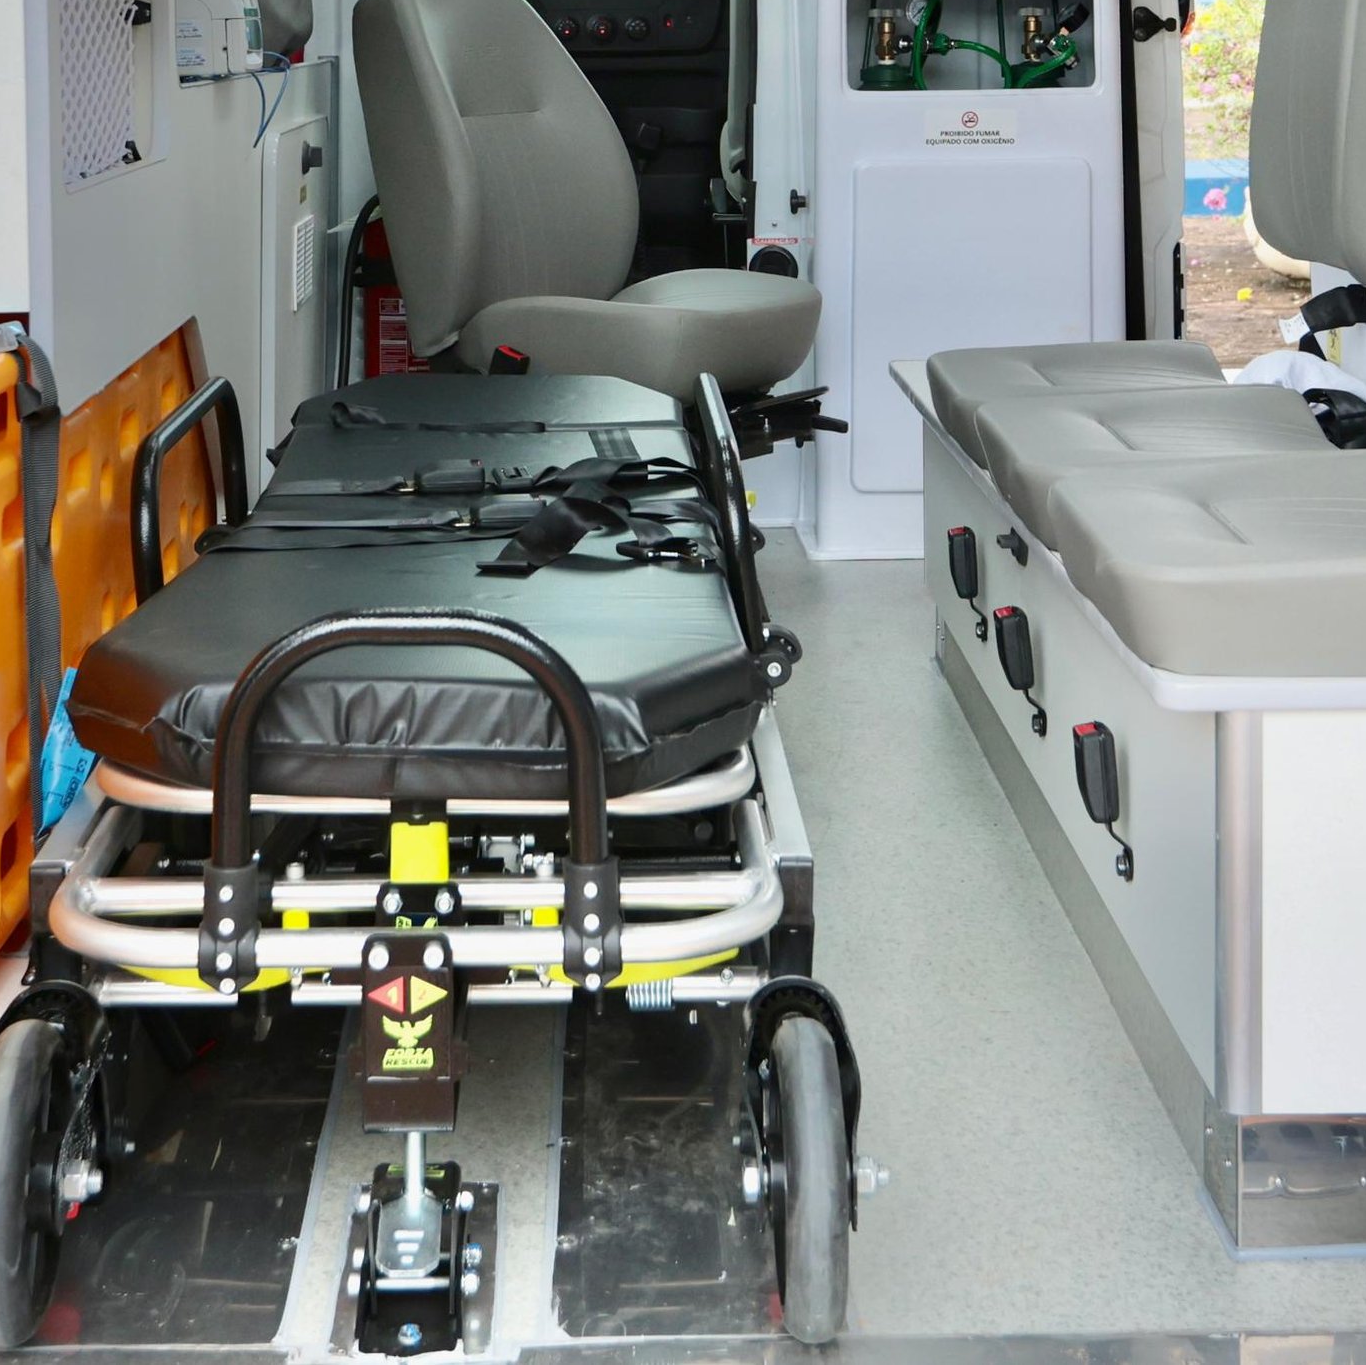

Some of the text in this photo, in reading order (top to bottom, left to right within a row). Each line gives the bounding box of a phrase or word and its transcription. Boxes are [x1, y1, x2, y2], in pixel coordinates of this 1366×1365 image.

[925, 138, 962, 146] EQUIPADO
[387, 986, 398, 1005] 1
[385, 1047, 433, 1057] FORZA
[385, 1058, 430, 1066] RESCUE
